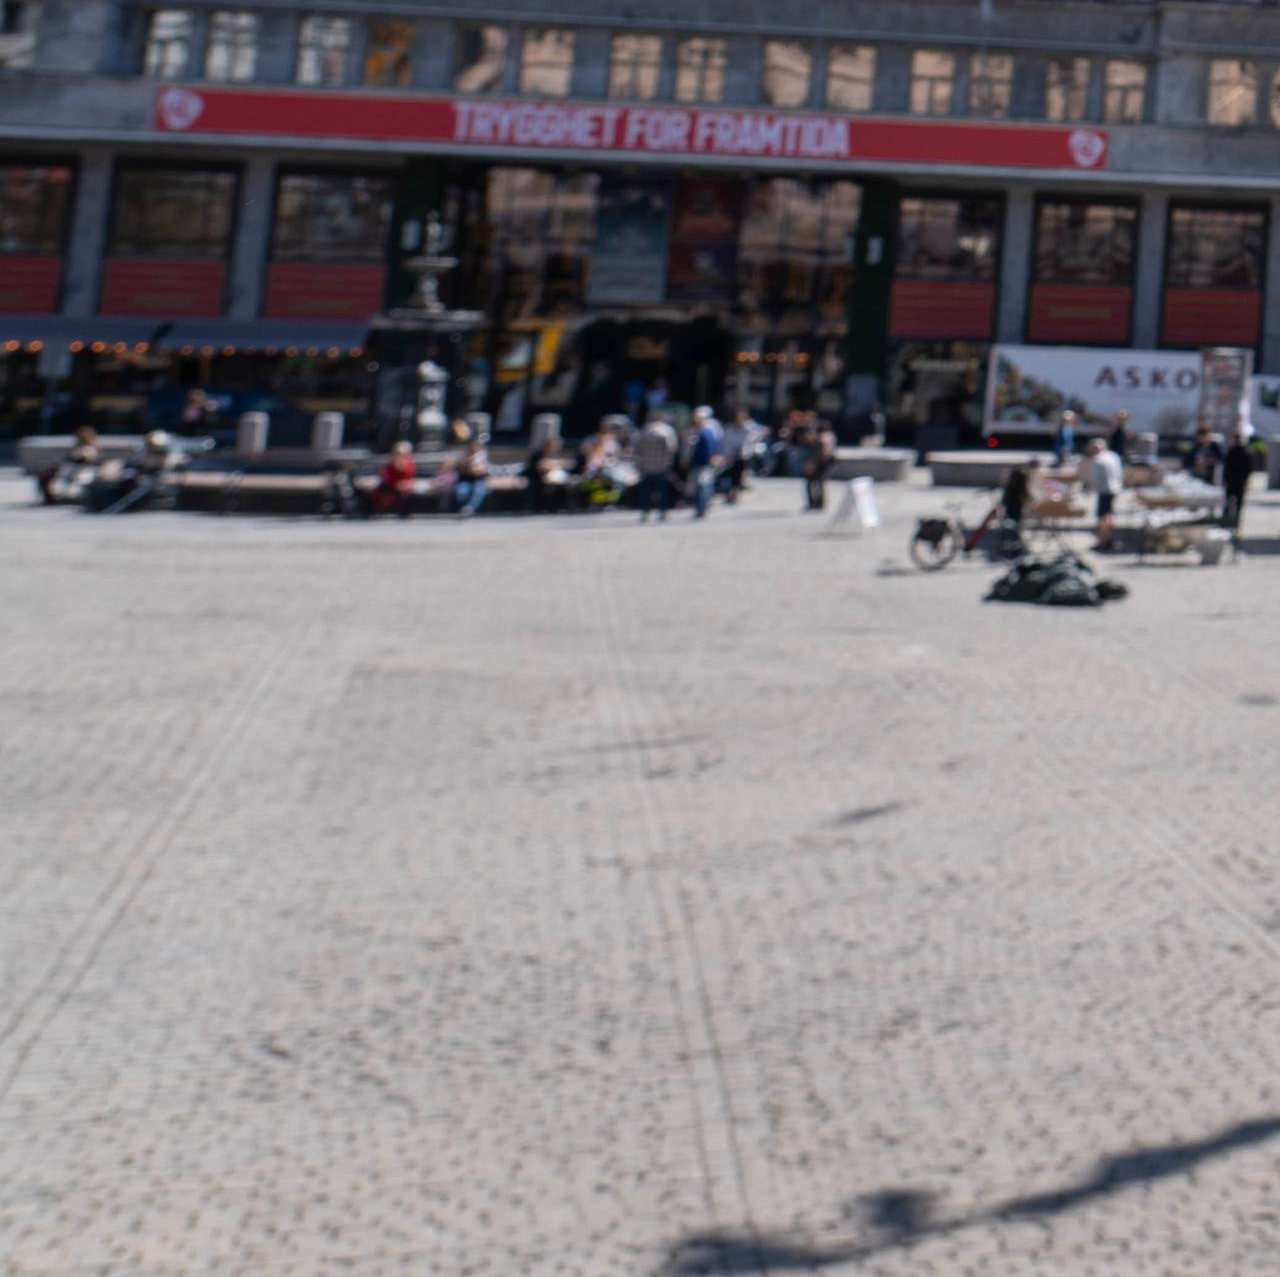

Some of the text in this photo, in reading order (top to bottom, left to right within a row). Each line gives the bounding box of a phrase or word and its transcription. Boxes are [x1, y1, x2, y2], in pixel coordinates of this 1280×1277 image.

[455, 101, 850, 156] TRYGGHET FOR FRAMTIDA
[1094, 364, 1199, 391] ASKO
